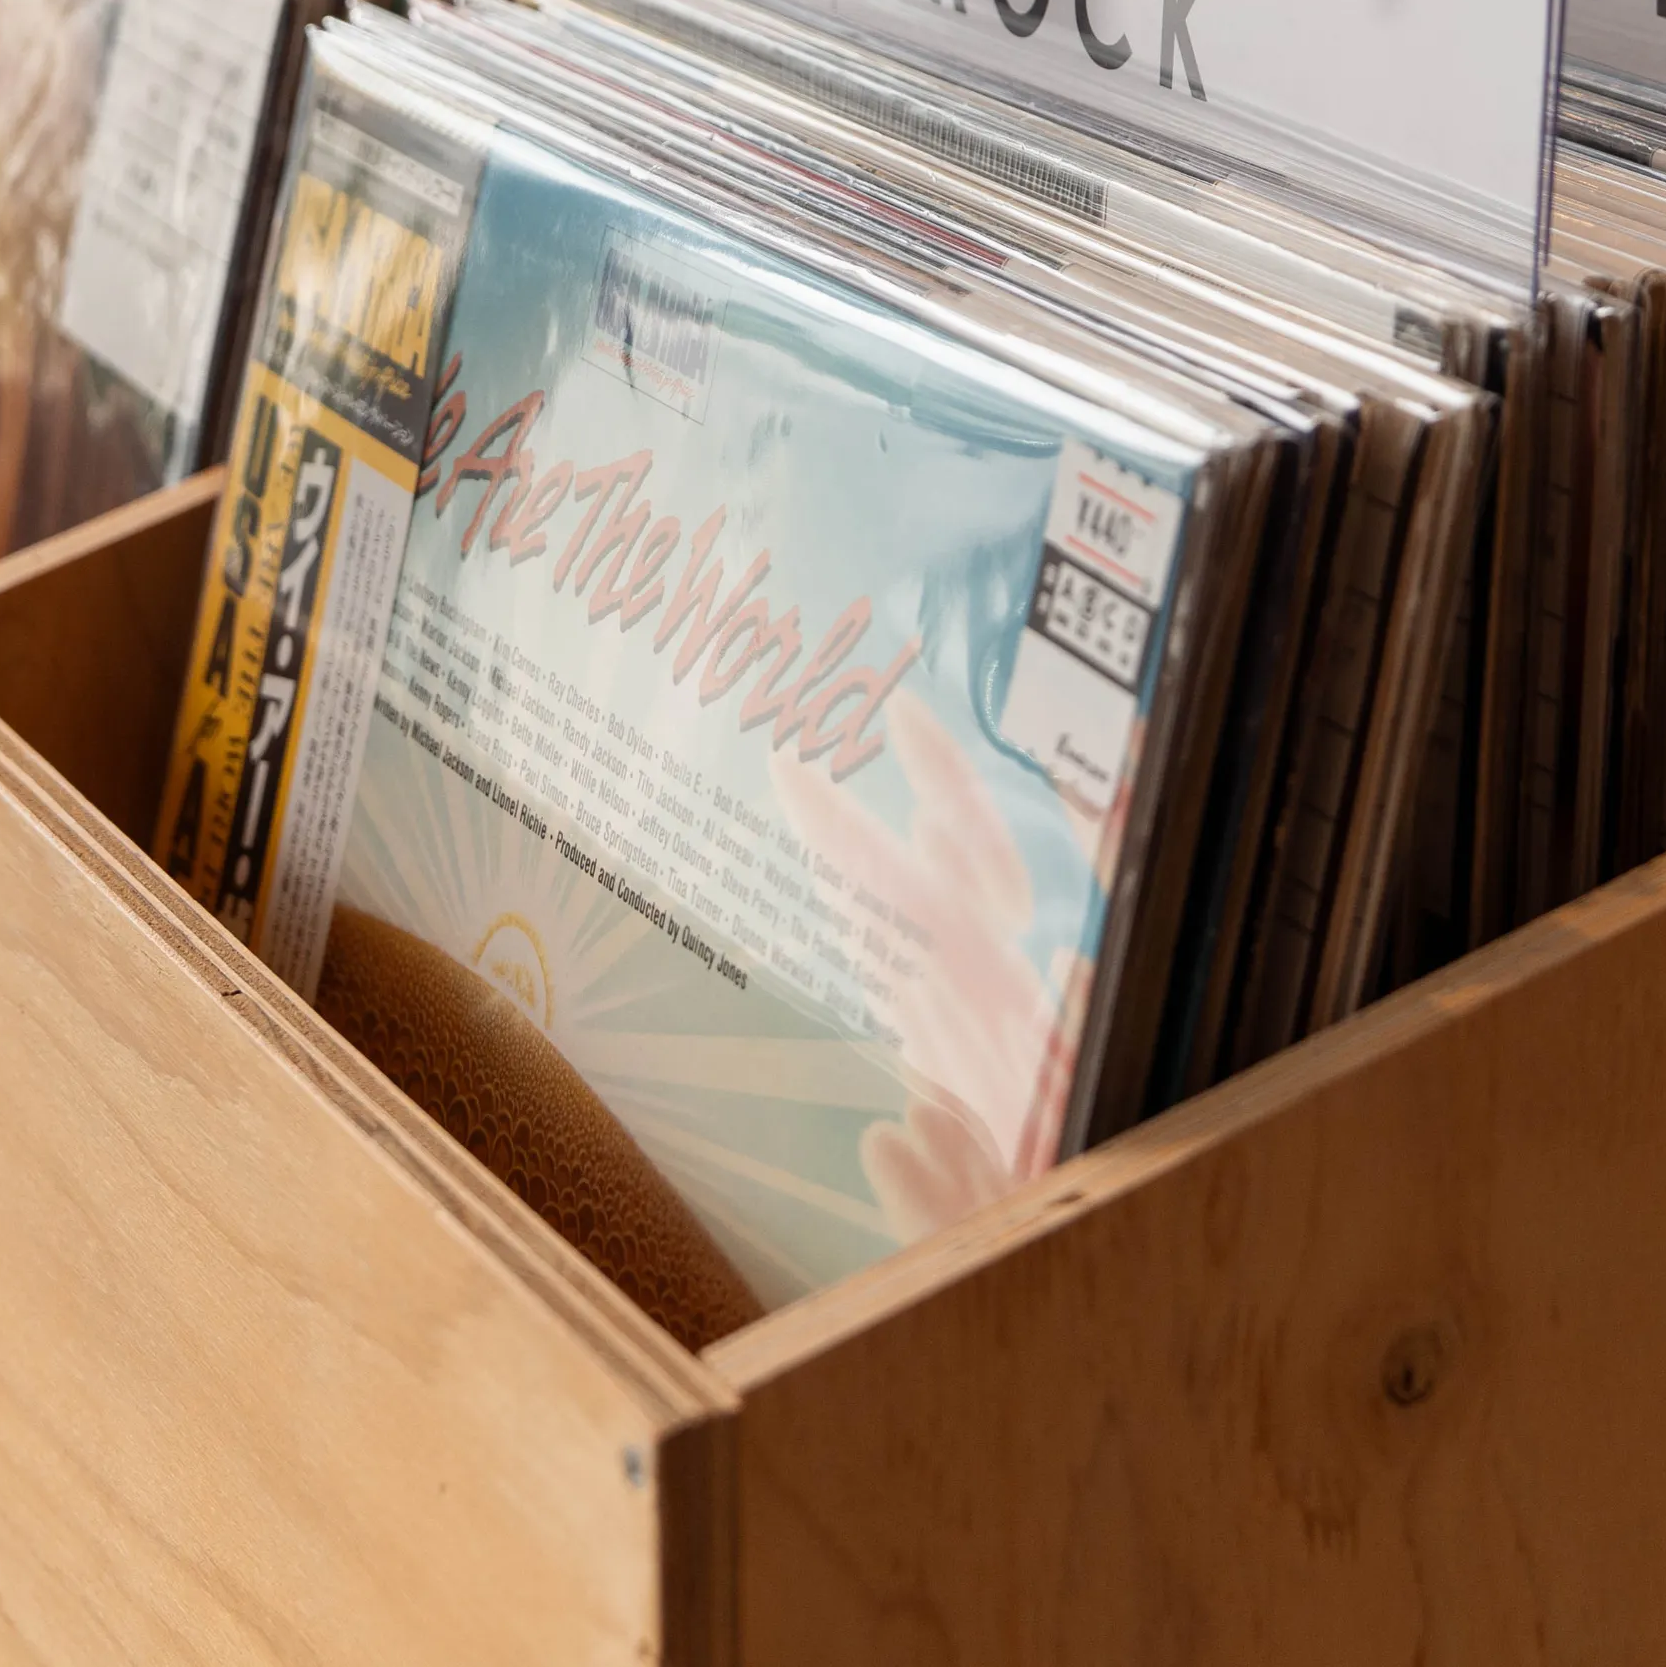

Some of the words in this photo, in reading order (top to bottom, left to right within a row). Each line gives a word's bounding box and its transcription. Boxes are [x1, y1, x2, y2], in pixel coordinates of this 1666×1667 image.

[436, 390, 573, 568] Are
[553, 448, 681, 632] The
[653, 503, 923, 783] World
[431, 693, 461, 731] Rogers
[491, 739, 513, 767] Ross
[519, 759, 540, 787] Paul
[540, 774, 569, 810] Simon
[575, 800, 602, 835] Bruce
[602, 820, 659, 880] Springsteen
[666, 867, 689, 898] Tina
[689, 883, 723, 923] Turner
[488, 665, 520, 702] Michael
[521, 689, 555, 727] Jackson
[561, 718, 591, 756] Randy
[591, 739, 628, 780] Jackson
[635, 770, 654, 799] Tito
[656, 785, 695, 827] Jackson
[703, 817, 715, 841] Al
[715, 826, 754, 868] Jarreau
[493, 633, 511, 660] Kim
[511, 646, 541, 681] Carnes
[547, 671, 565, 701] Ray
[566, 684, 601, 722] Charles
[607, 712, 625, 740] Bob
[625, 726, 653, 763] Dylan
[661, 750, 693, 787] Sheila
[713, 786, 733, 815] Bob
[510, 716, 533, 746] Bette
[534, 732, 563, 767] Midler
[570, 758, 597, 793] Willie
[598, 779, 631, 817] Nelson
[636, 807, 670, 850] Jeffrey
[672, 832, 713, 876] Osborne
[720, 866, 750, 903] Steve
[411, 720, 442, 757] Michael
[442, 745, 475, 783] Jackson
[475, 769, 491, 796] and
[492, 783, 519, 817] Lionel
[519, 803, 548, 839] Richie
[555, 831, 597, 877] Produced
[597, 862, 616, 891] and
[616, 876, 666, 929] Conducted
[666, 914, 680, 943] by
[680, 924, 718, 971] Quincy
[717, 951, 748, 989] Jones
